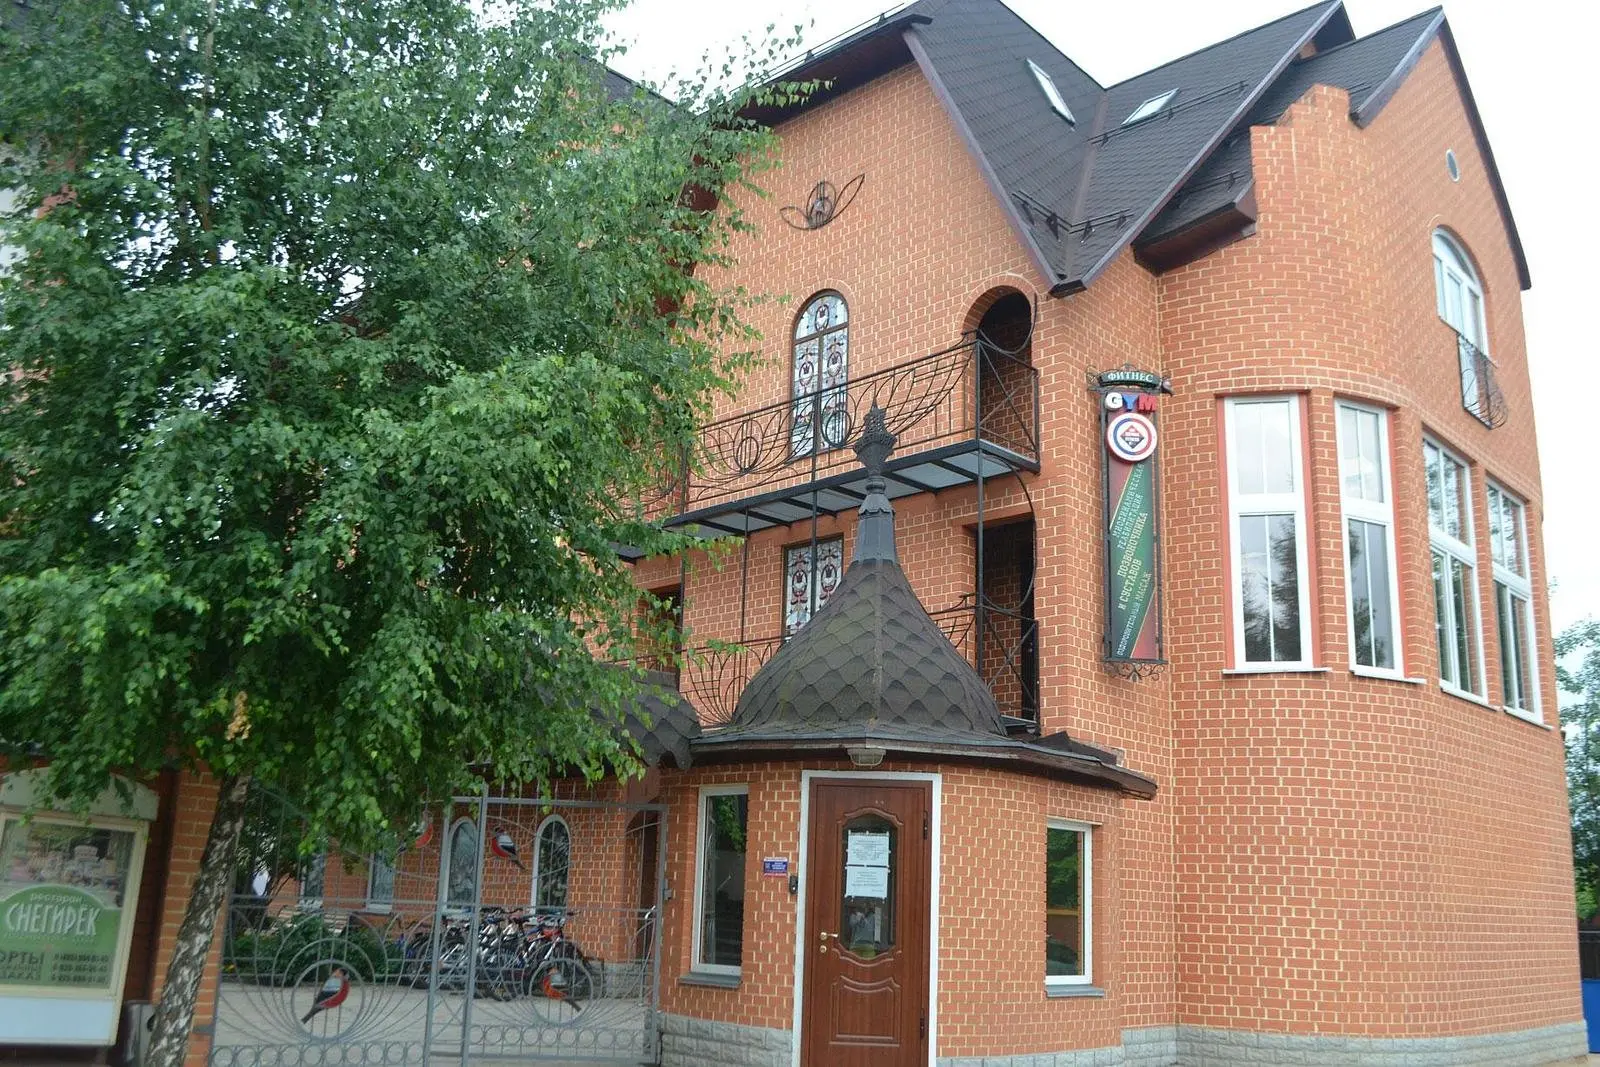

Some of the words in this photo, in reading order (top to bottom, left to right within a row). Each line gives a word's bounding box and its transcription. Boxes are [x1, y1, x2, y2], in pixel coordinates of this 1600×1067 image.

[1107, 371, 1154, 382] ФИТНЕС
[1117, 512, 1149, 577] ПОЗВОНОЧНИКА
[1119, 558, 1142, 603] СУСТАВОВ
